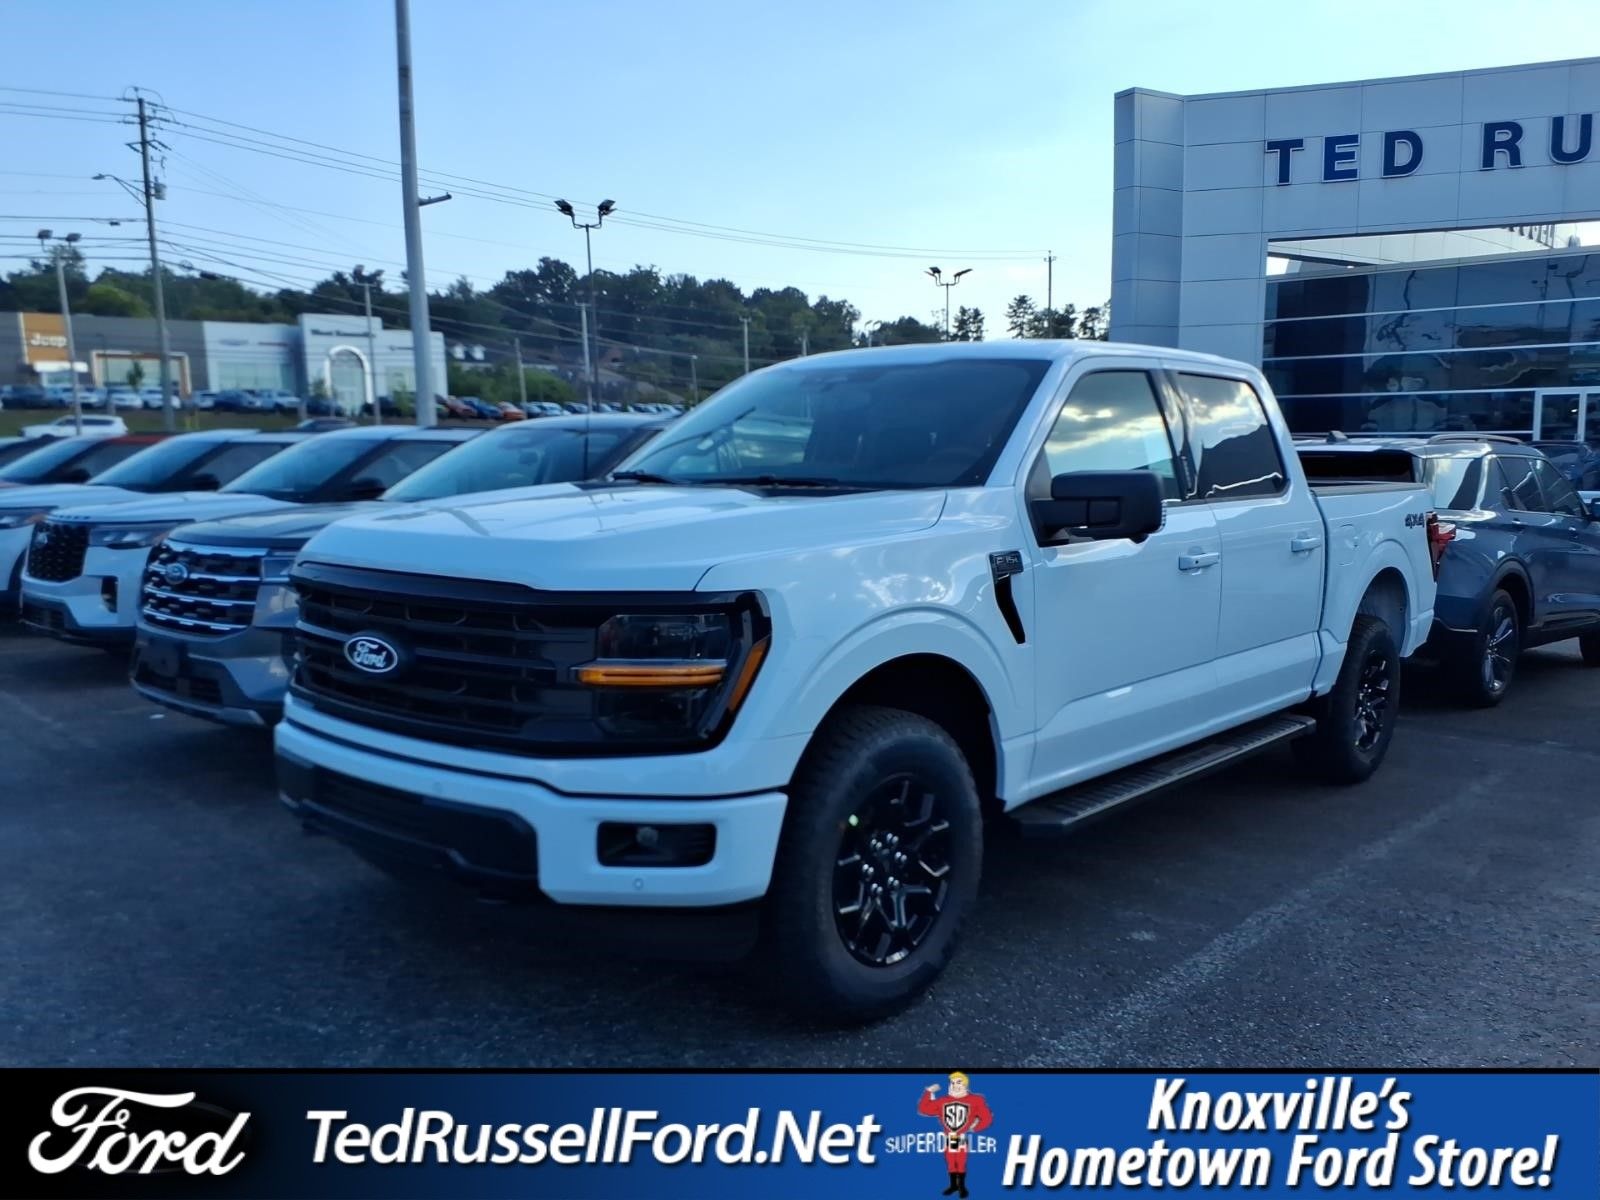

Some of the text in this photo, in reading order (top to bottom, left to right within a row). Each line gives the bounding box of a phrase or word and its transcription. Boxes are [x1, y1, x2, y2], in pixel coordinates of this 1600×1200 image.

[1265, 113, 1593, 186] TED RU
[31, 332, 67, 348] Jeep
[353, 641, 387, 668] Ford
